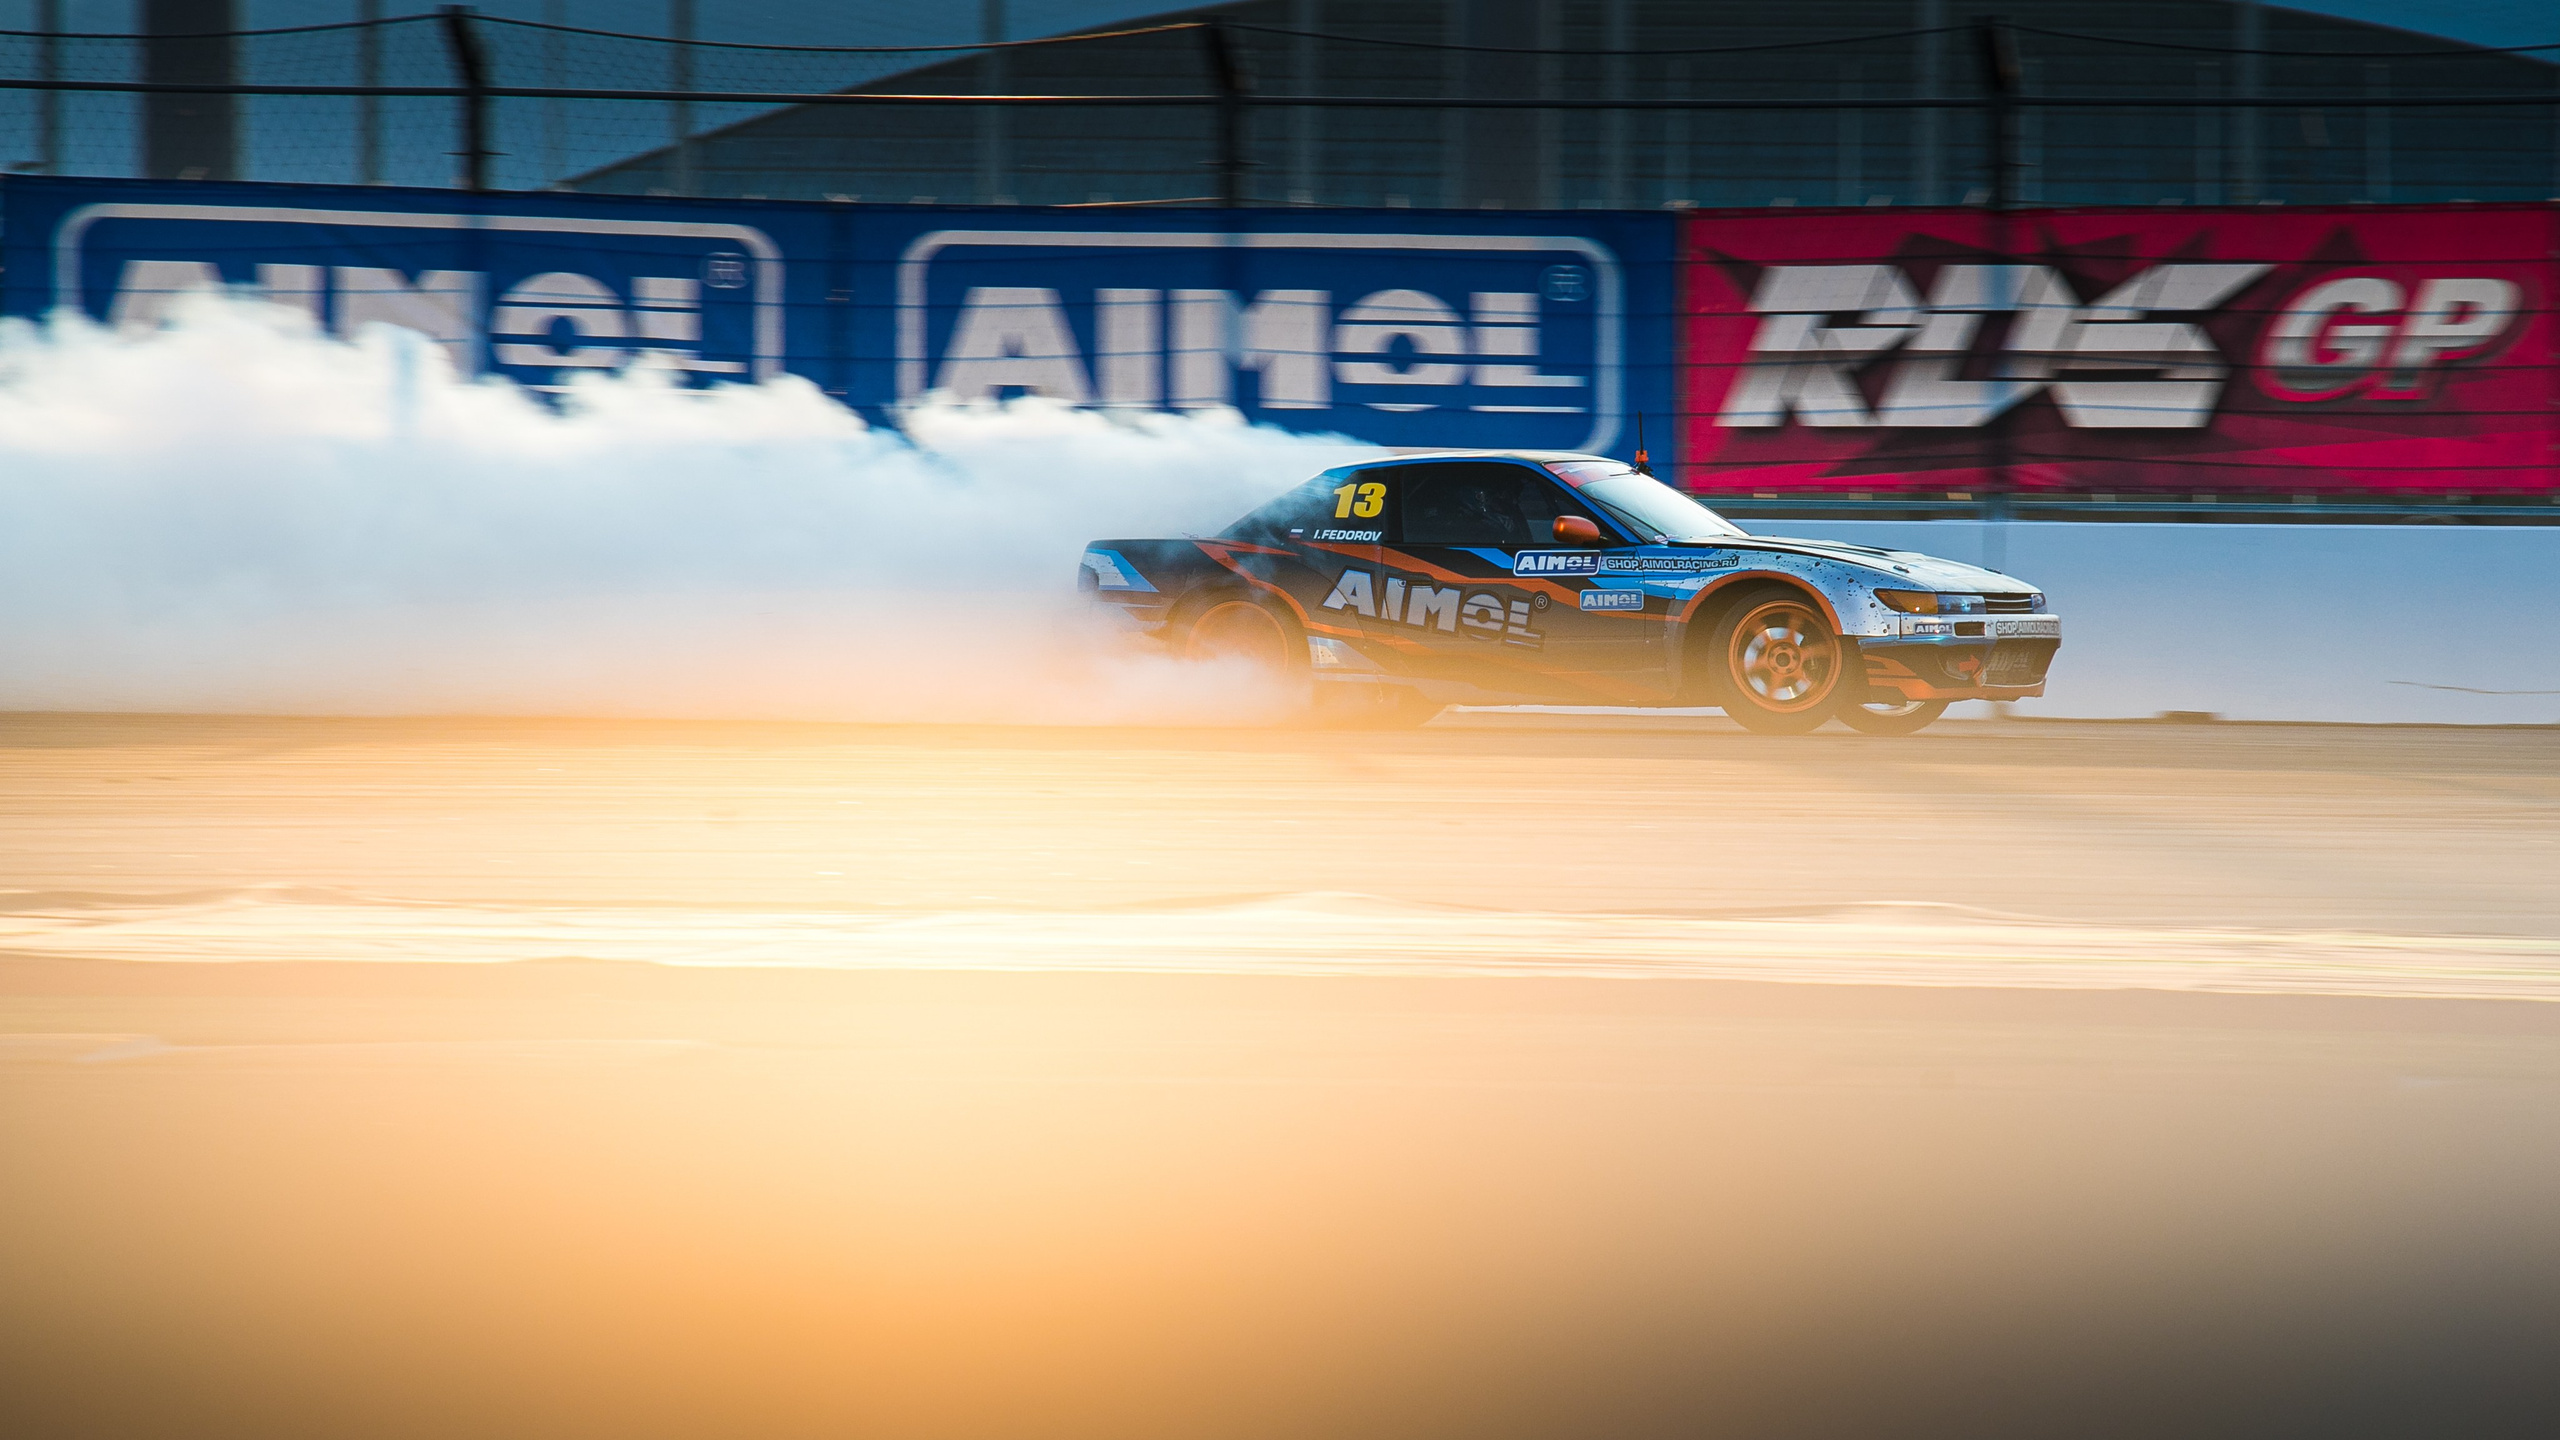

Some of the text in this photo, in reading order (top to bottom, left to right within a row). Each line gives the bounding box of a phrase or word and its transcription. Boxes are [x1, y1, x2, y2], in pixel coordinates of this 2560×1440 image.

[926, 286, 1587, 414] AIMOL
[1711, 263, 2525, 428] RDS GP
[1333, 483, 1387, 518] 13
[1313, 529, 1382, 541] I.FEDOROV
[1516, 555, 1596, 572] AIMOL
[1607, 557, 1738, 570] SHOP.AIMOLRACING.RU
[1320, 567, 1543, 649] AIMOL
[1582, 593, 1642, 608] AIMOL
[1915, 624, 1952, 635] AIMOL
